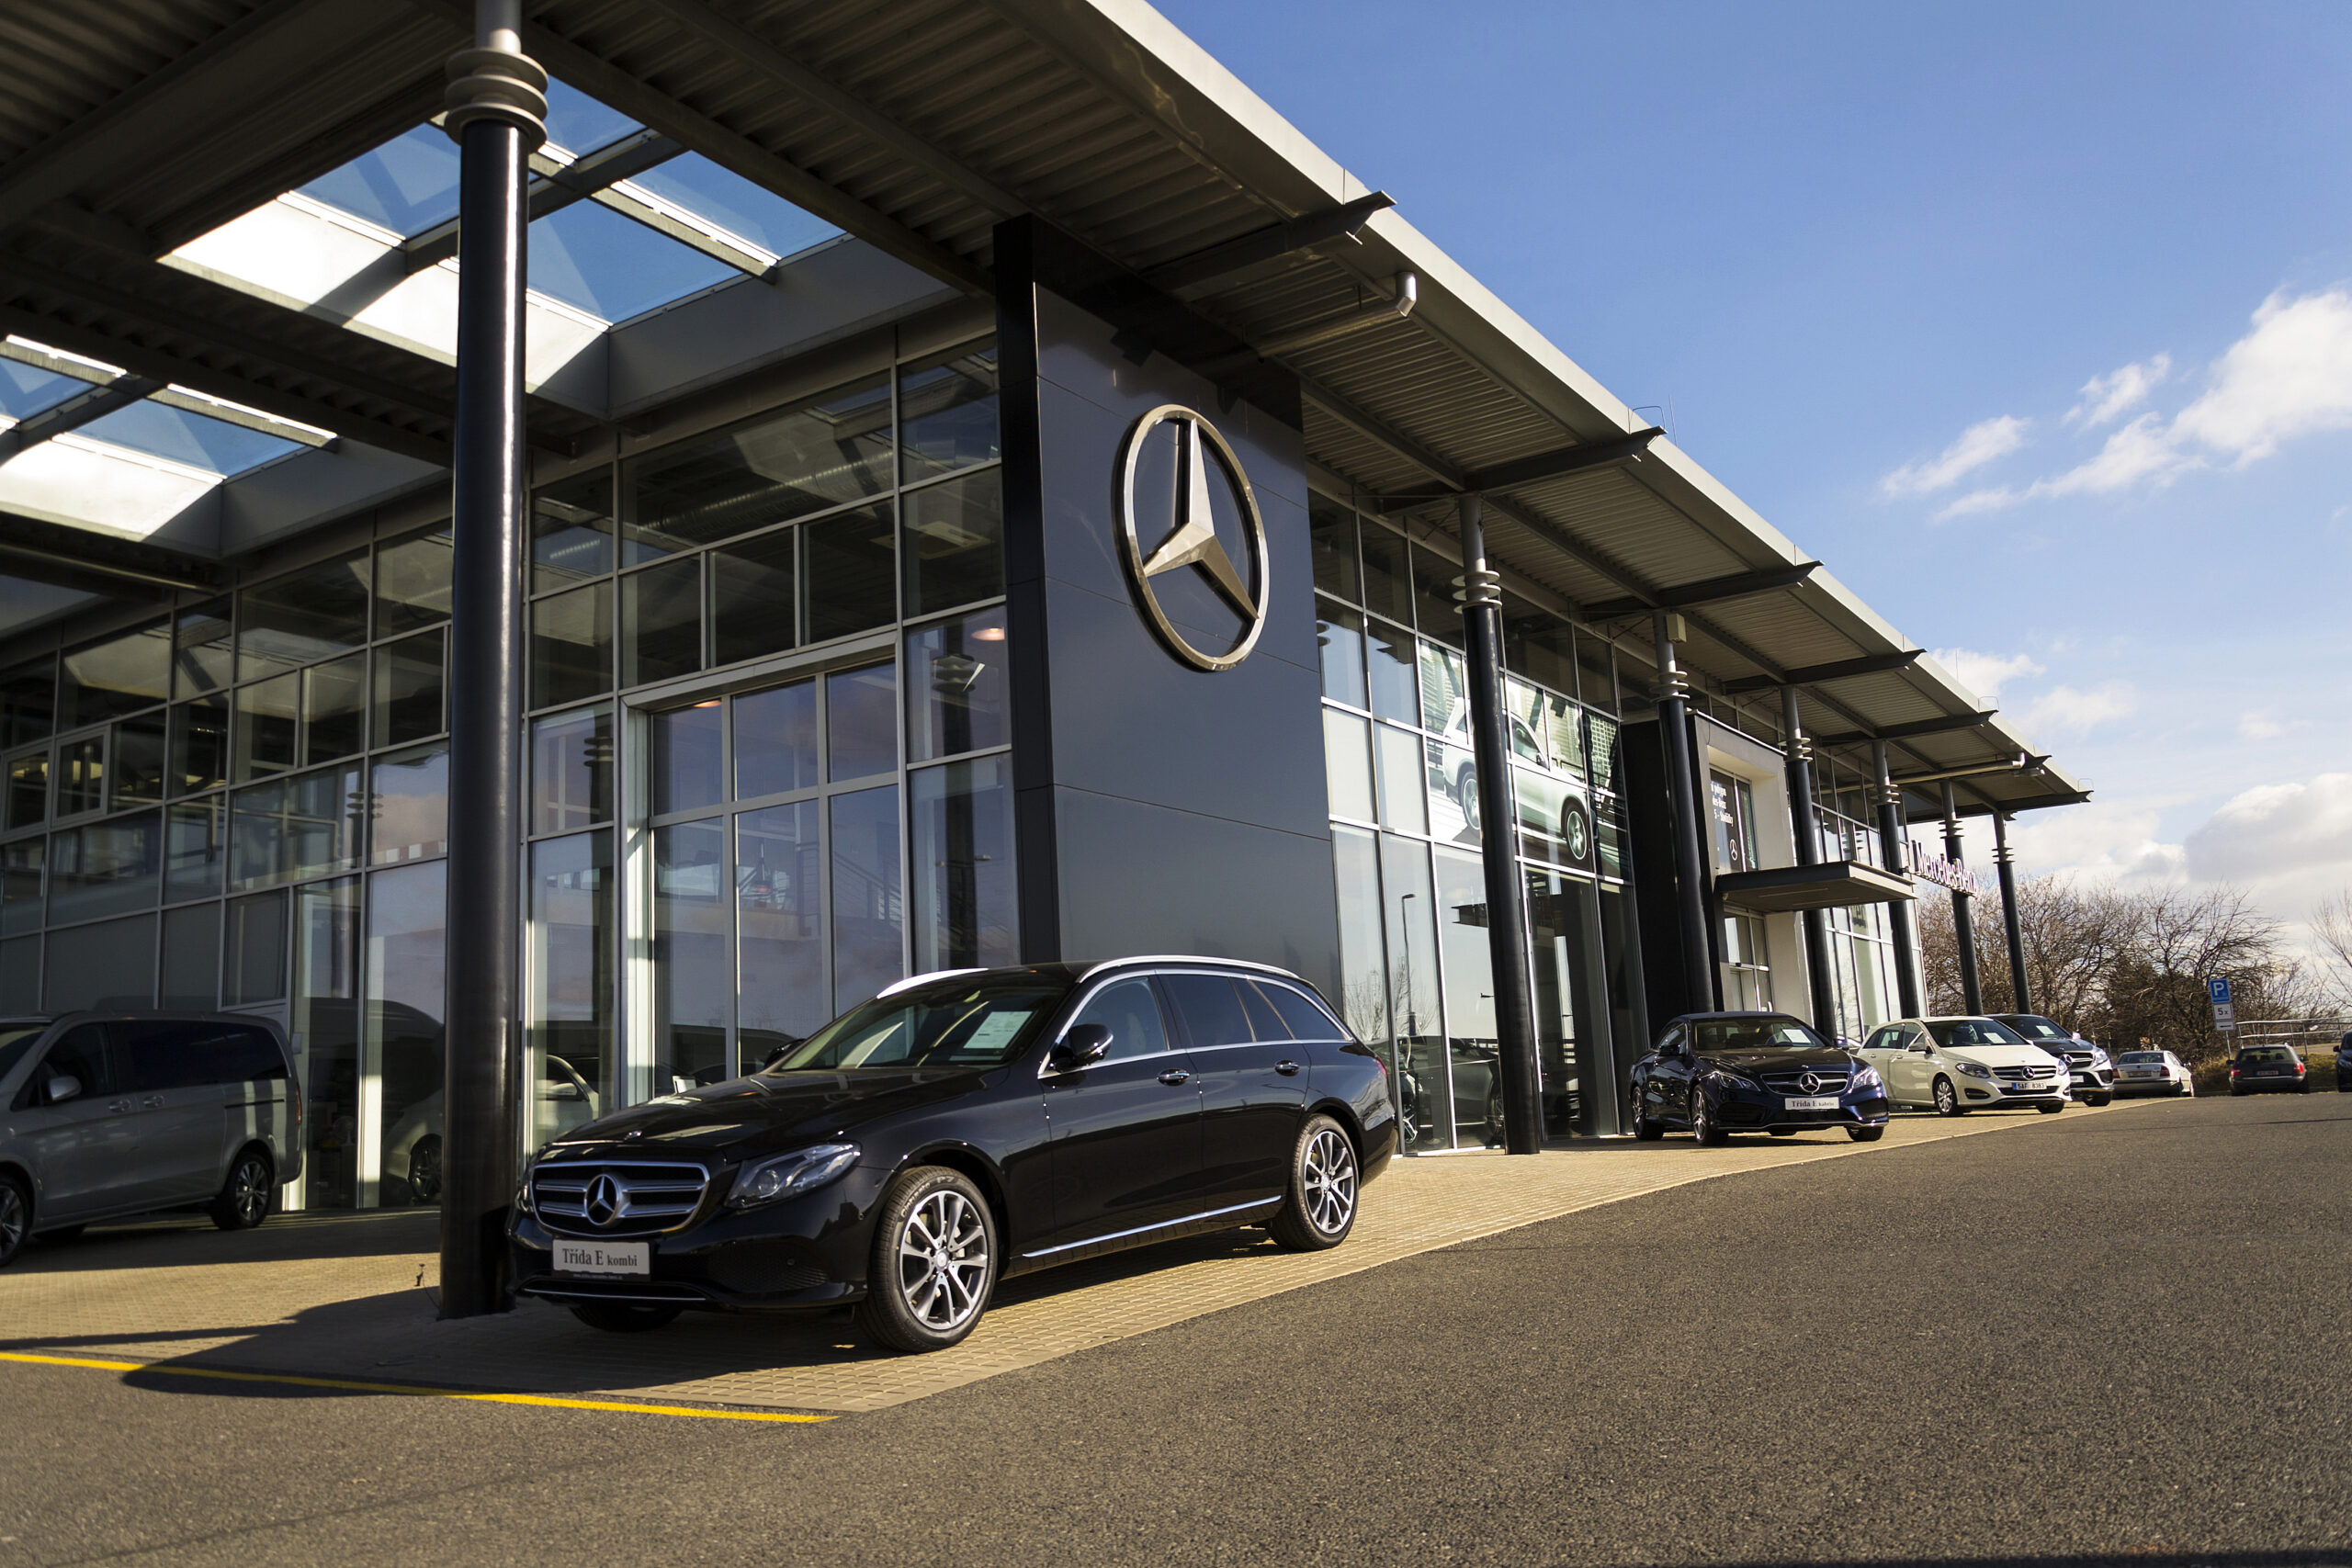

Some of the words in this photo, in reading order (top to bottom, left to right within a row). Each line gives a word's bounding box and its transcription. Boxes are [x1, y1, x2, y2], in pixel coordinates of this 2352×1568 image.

[2213, 982, 2224, 996] P
[936, 1176, 956, 1184] P7
[562, 1247, 593, 1266] Třída
[595, 1249, 604, 1266] E
[606, 1254, 639, 1267] kombi
